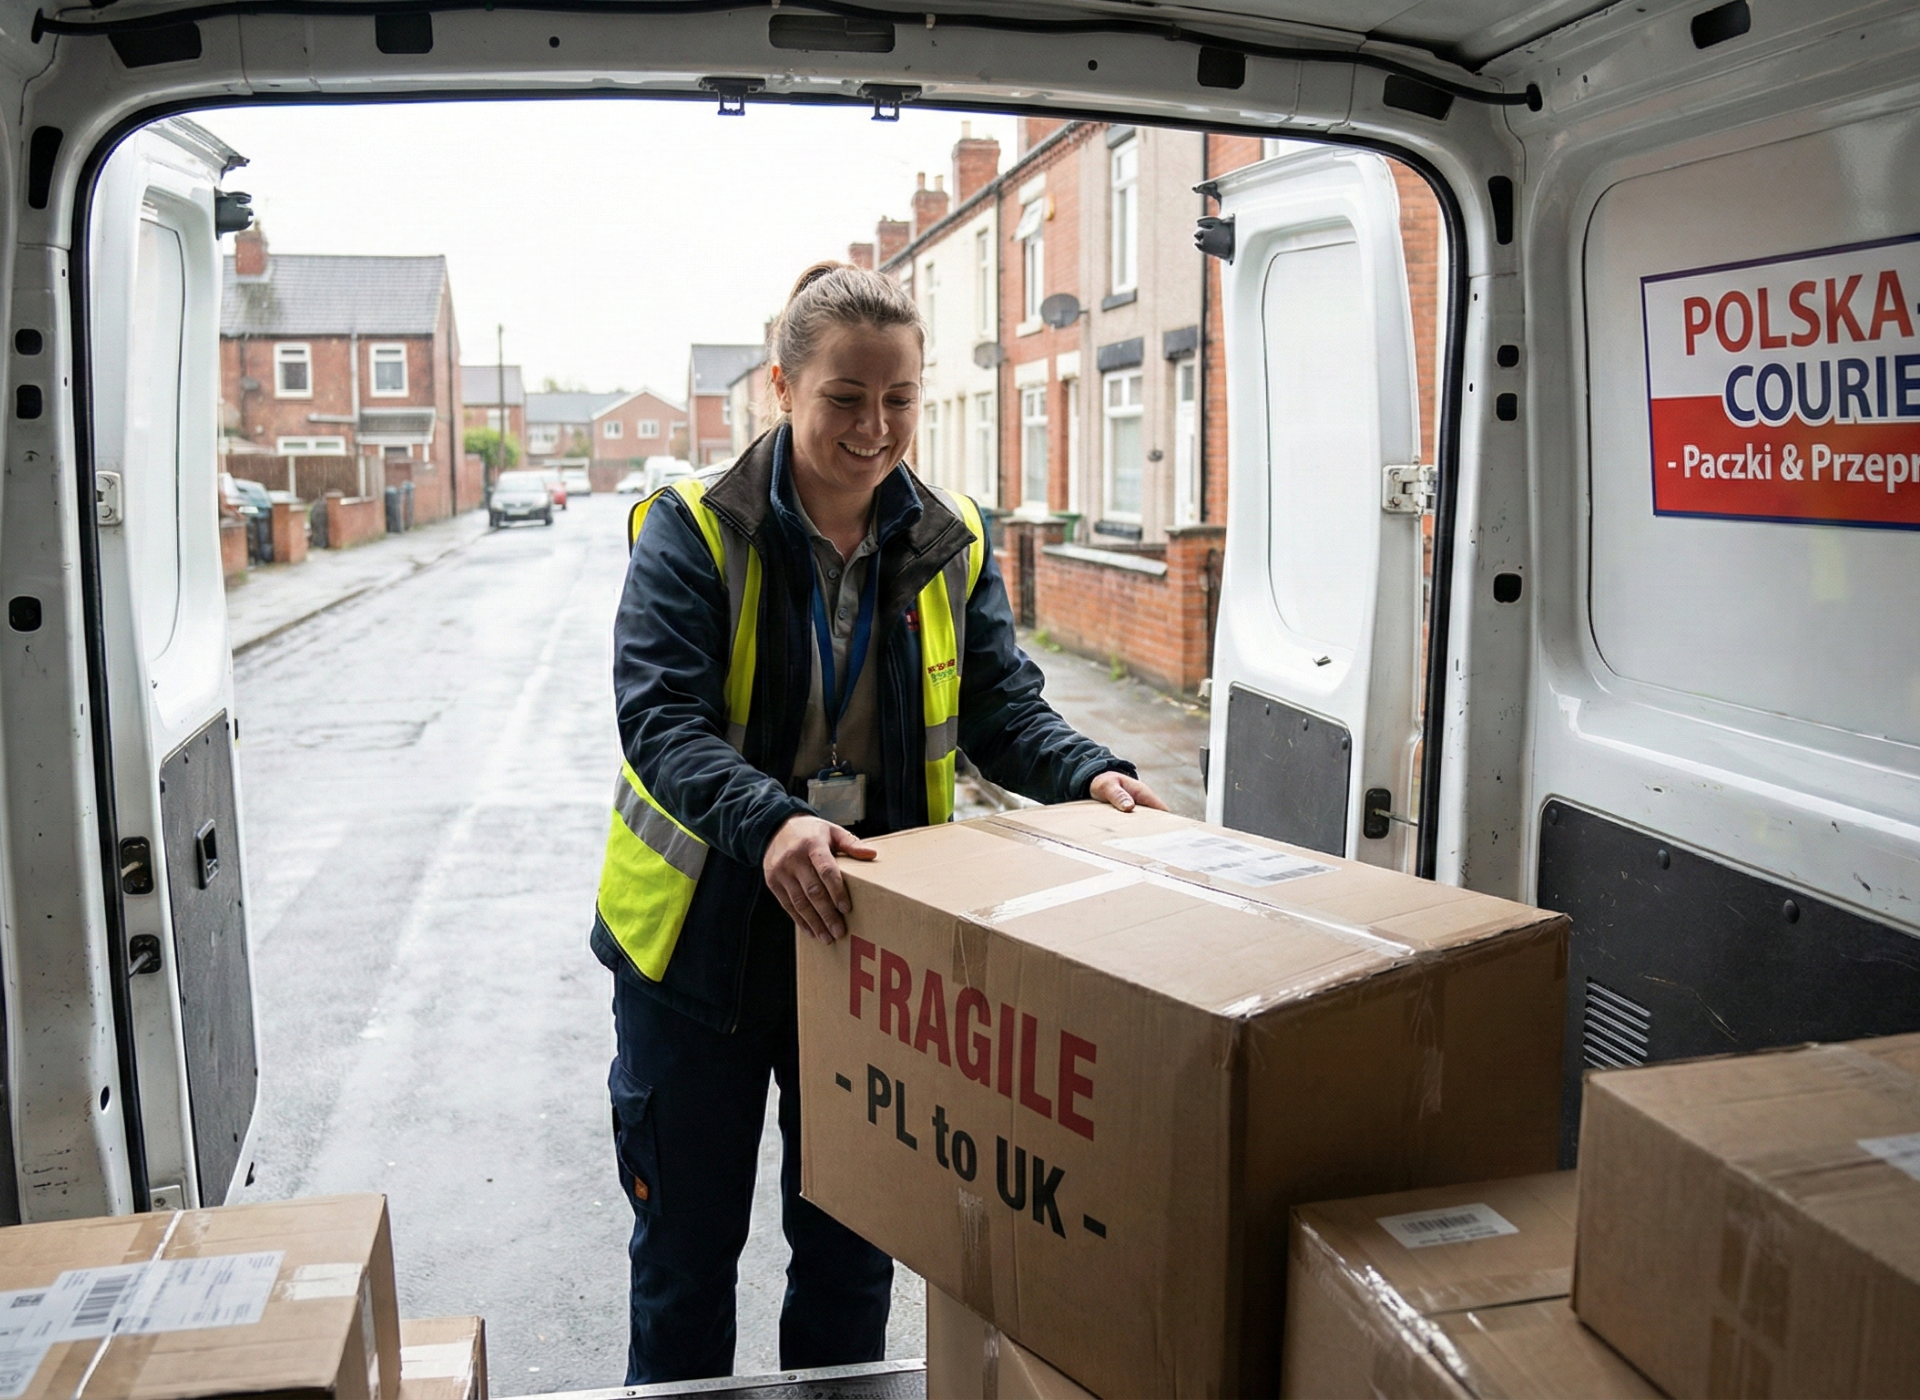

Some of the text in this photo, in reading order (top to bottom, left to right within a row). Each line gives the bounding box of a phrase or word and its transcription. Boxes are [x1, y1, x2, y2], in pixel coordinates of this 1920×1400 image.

[1683, 269, 1920, 356] POLSKA
[1725, 354, 1920, 422] COURIE
[1683, 443, 1772, 480] Paczki
[1780, 444, 1804, 481] &
[849, 933, 1097, 1142] FRAGILE
[866, 1062, 918, 1151] PL
[931, 1104, 977, 1182] to
[996, 1134, 1066, 1239] UK
